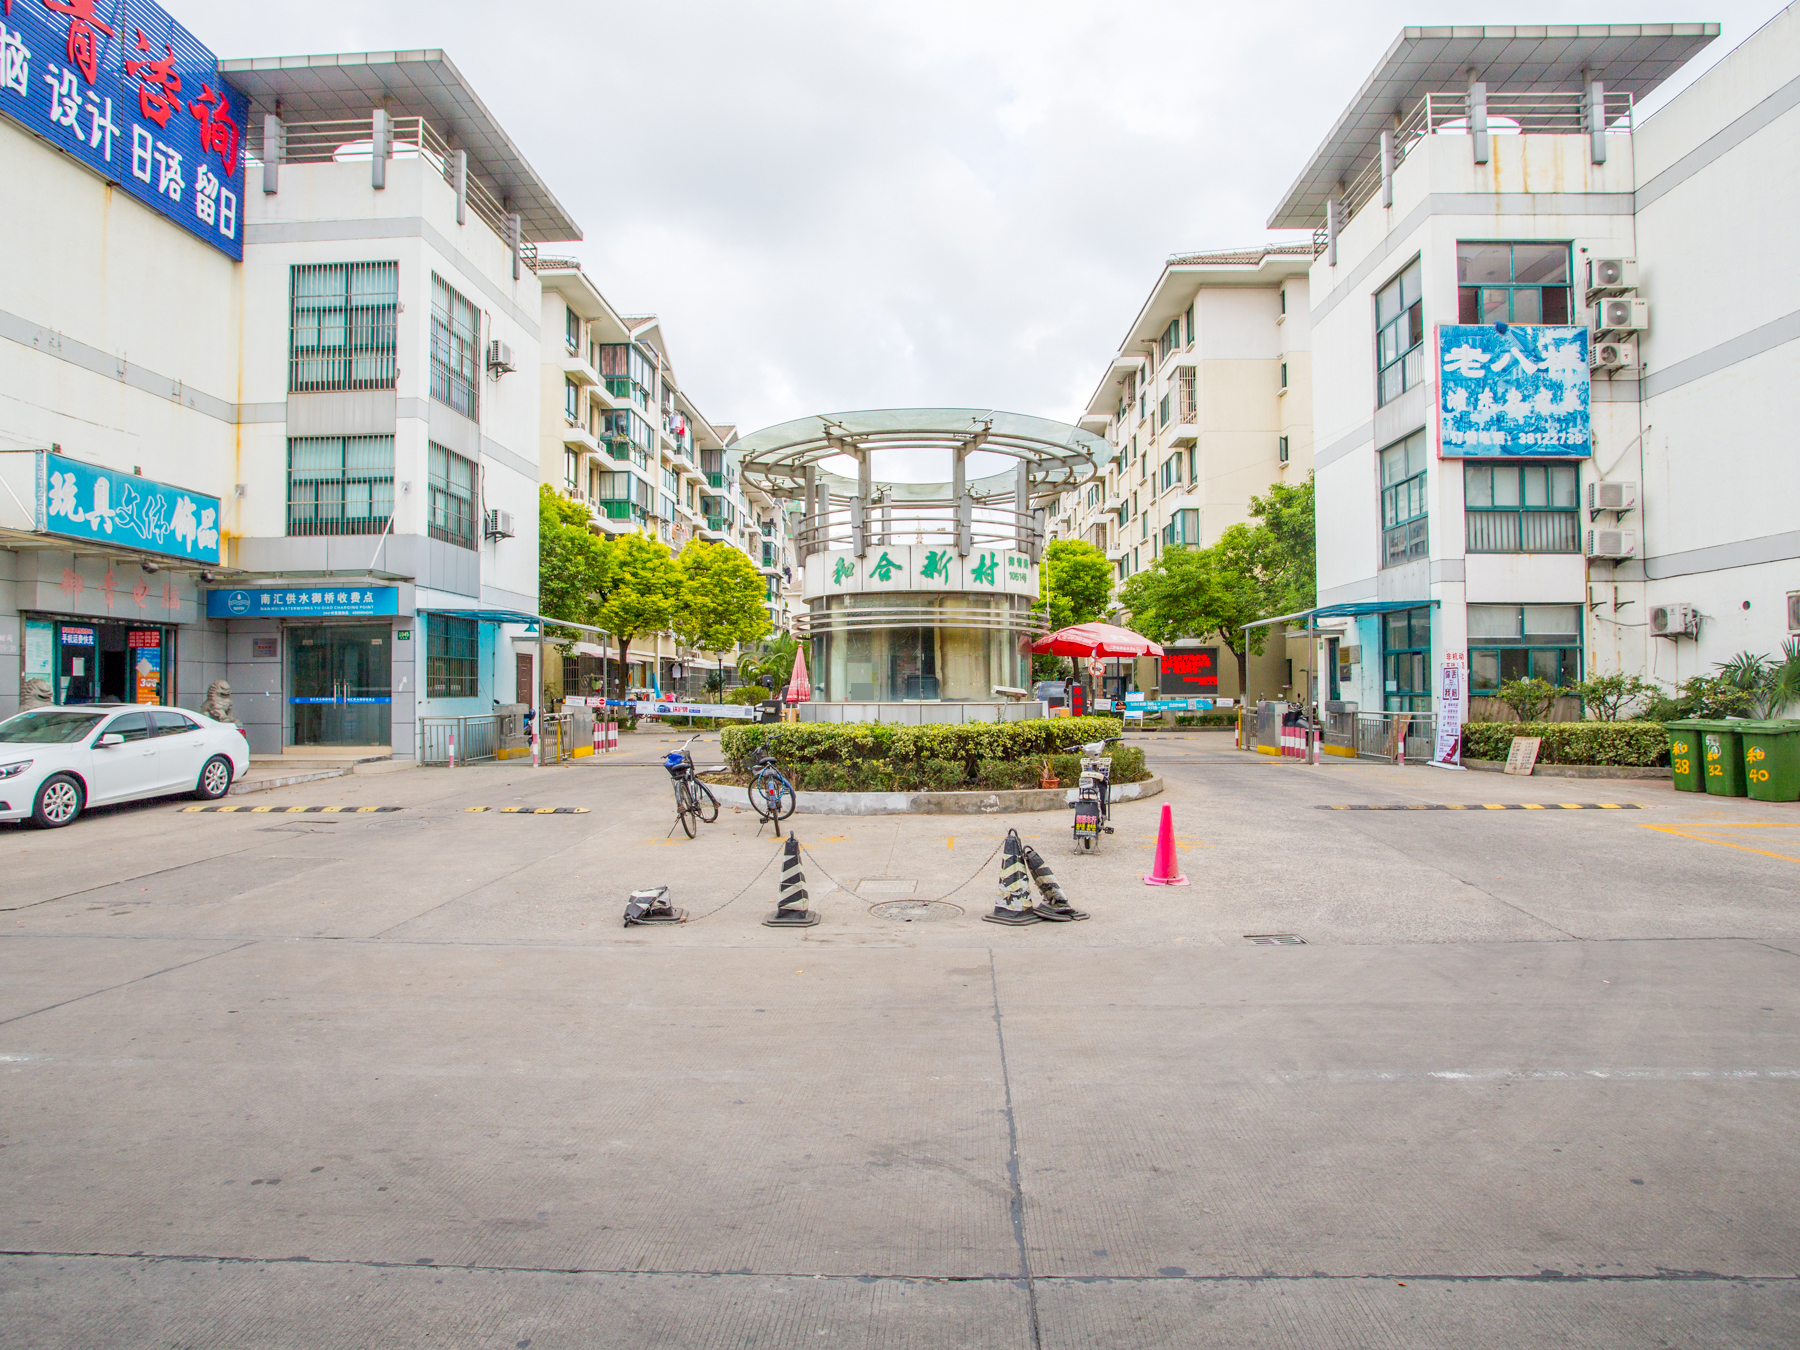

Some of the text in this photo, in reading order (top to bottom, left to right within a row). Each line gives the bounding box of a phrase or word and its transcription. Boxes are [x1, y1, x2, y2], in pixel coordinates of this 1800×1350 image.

[43, 63, 121, 162] 设计
[132, 123, 186, 202] 日语
[195, 163, 237, 240] 留日
[1443, 343, 1587, 379] 老八样
[1518, 432, 1583, 445] 38122738
[833, 549, 999, 586] 和合新村
[260, 591, 374, 605] 南汇供水御桥收费点
[1672, 740, 1689, 756] 和
[1746, 746, 1766, 764] 和
[1674, 758, 1690, 775] 38
[1708, 764, 1723, 776] 32
[1749, 768, 1770, 783] 40
